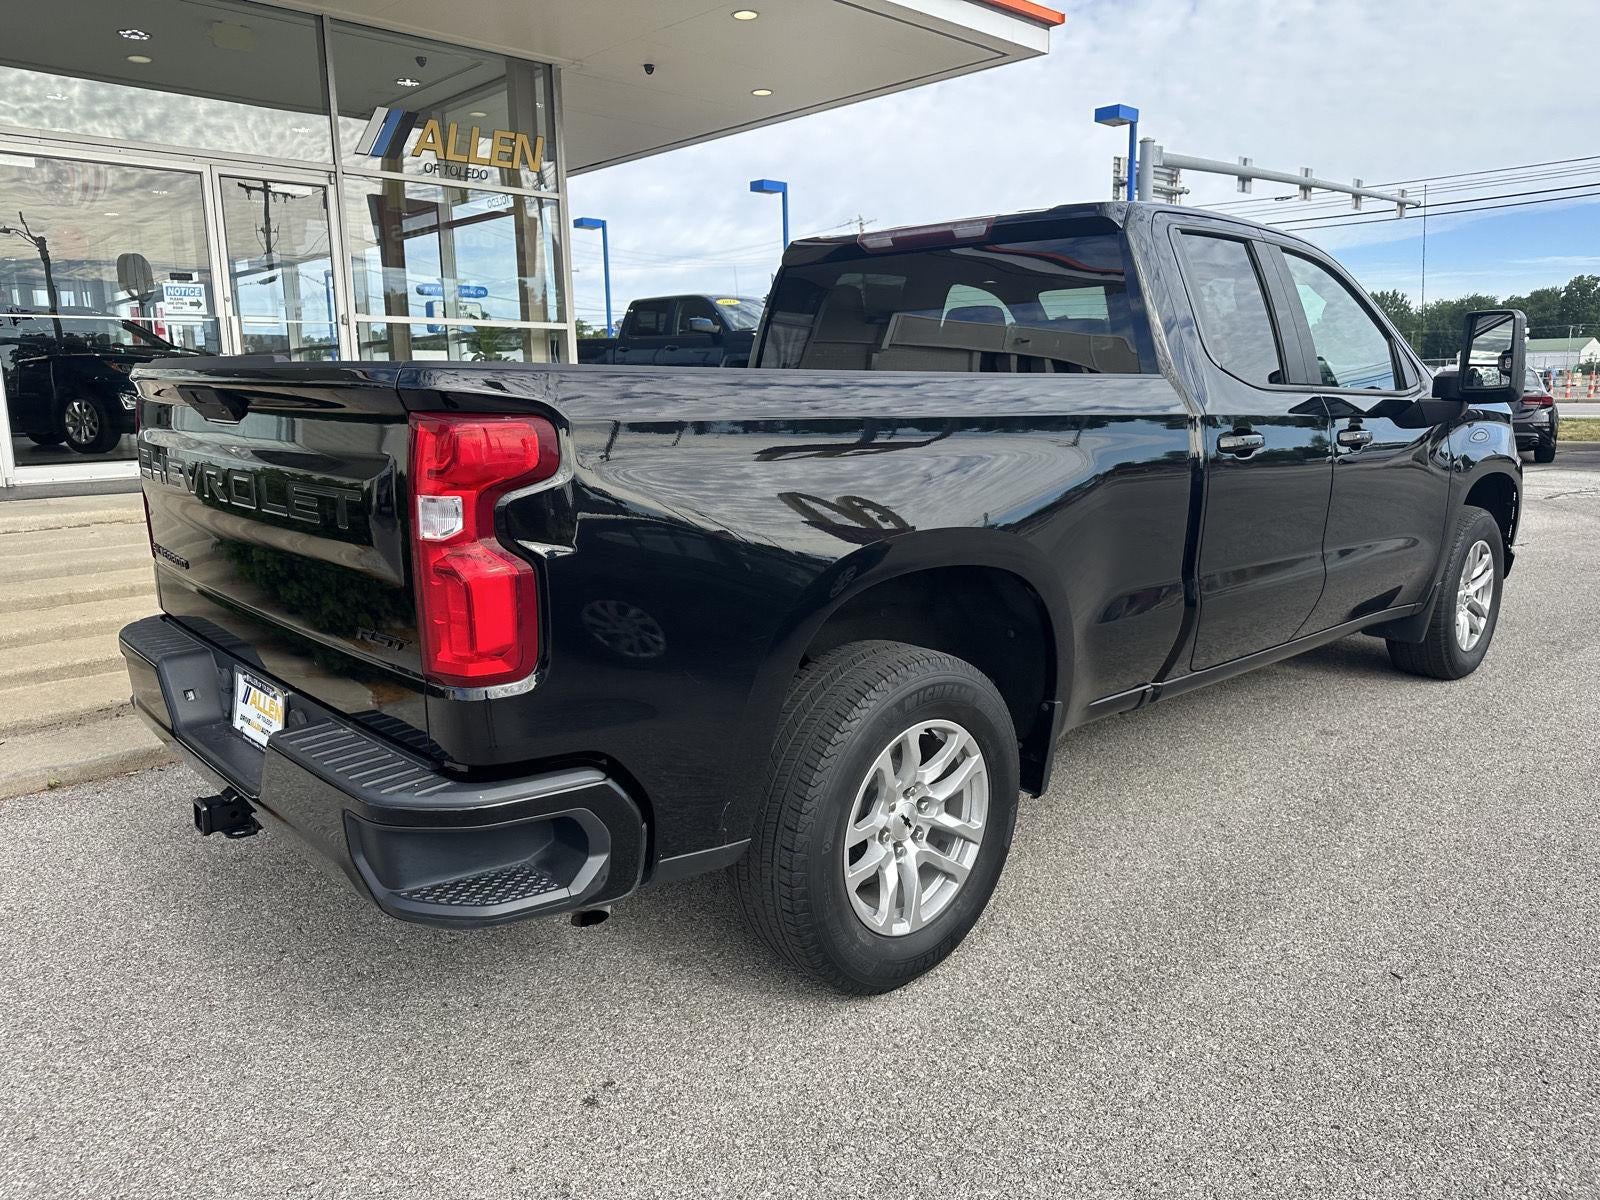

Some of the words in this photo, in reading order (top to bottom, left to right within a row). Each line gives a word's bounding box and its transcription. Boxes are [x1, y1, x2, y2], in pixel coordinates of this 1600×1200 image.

[411, 118, 545, 173] ALLEN
[424, 162, 440, 174] OF
[444, 164, 489, 180] TOLEDO
[167, 287, 201, 296] NOTICE
[139, 447, 362, 529] CHEVROLET
[250, 689, 283, 724] ALLEN
